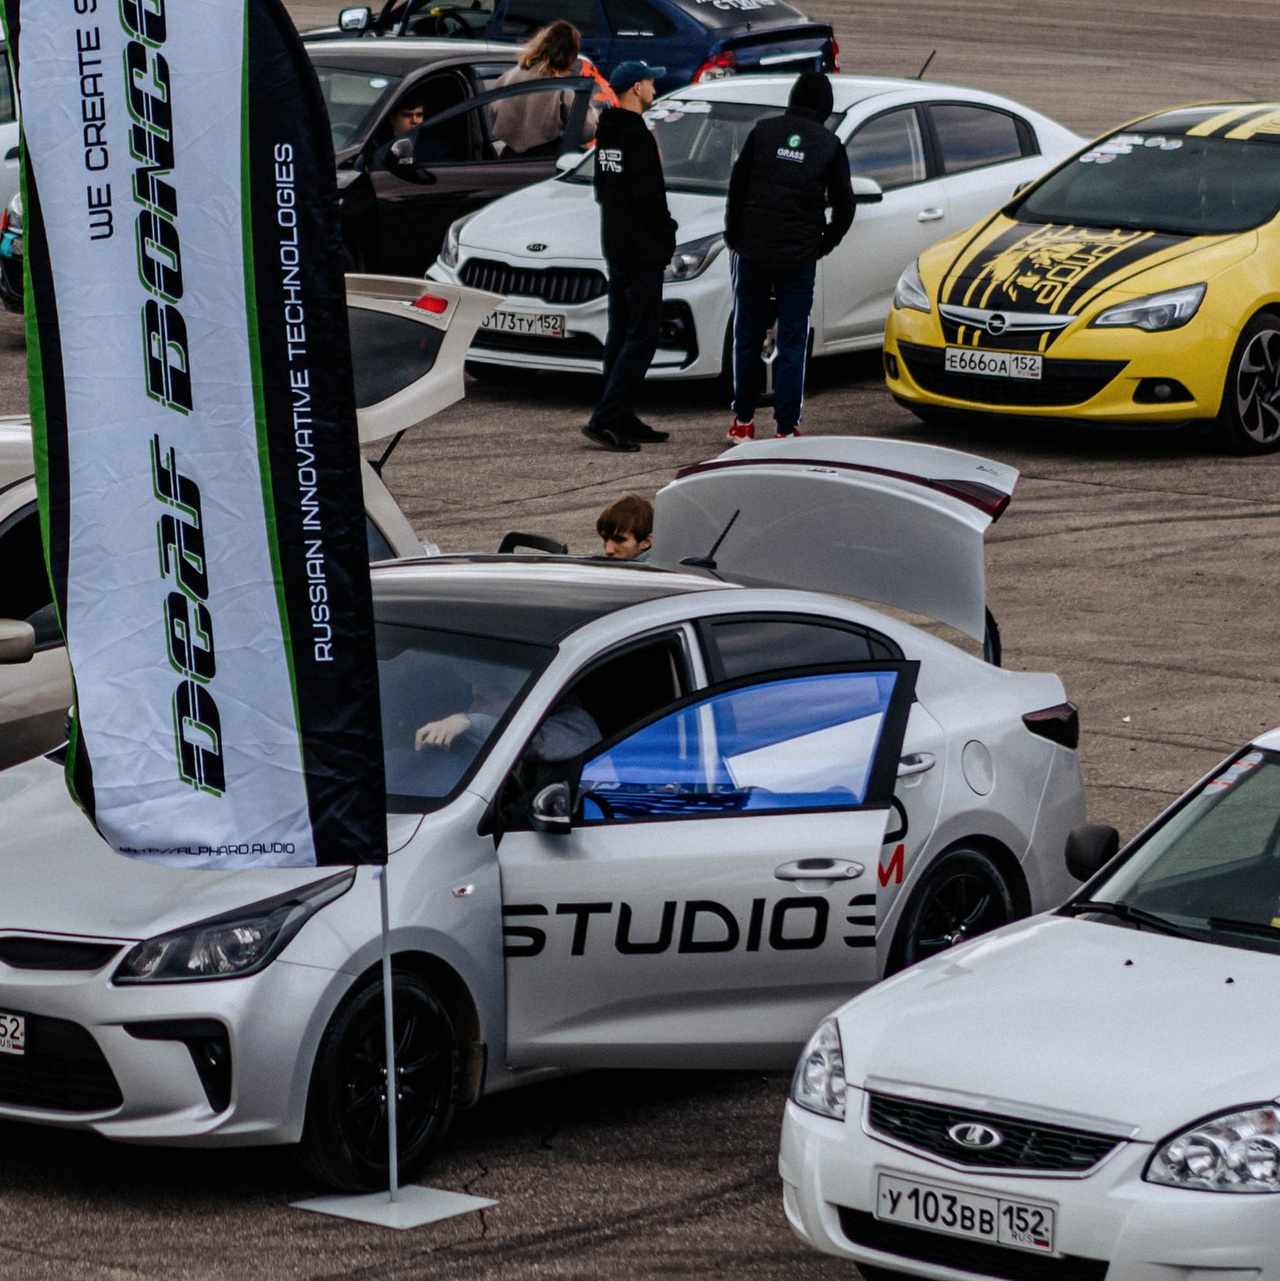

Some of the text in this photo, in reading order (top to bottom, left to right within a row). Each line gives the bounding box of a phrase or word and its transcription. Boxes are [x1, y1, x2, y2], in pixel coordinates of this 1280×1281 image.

[76, 27, 110, 171] CREATE
[777, 147, 805, 161] GRASS
[87, 183, 114, 241] WE
[537, 315, 558, 330] 152
[950, 352, 1037, 373] Е666ОА 152
[274, 142, 334, 662] RUSSIAN INNOVATIVE TECHNOLOGIES
[888, 1187, 1045, 1237] У103ВВ 152
[1011, 1230, 1033, 1244] RUS
